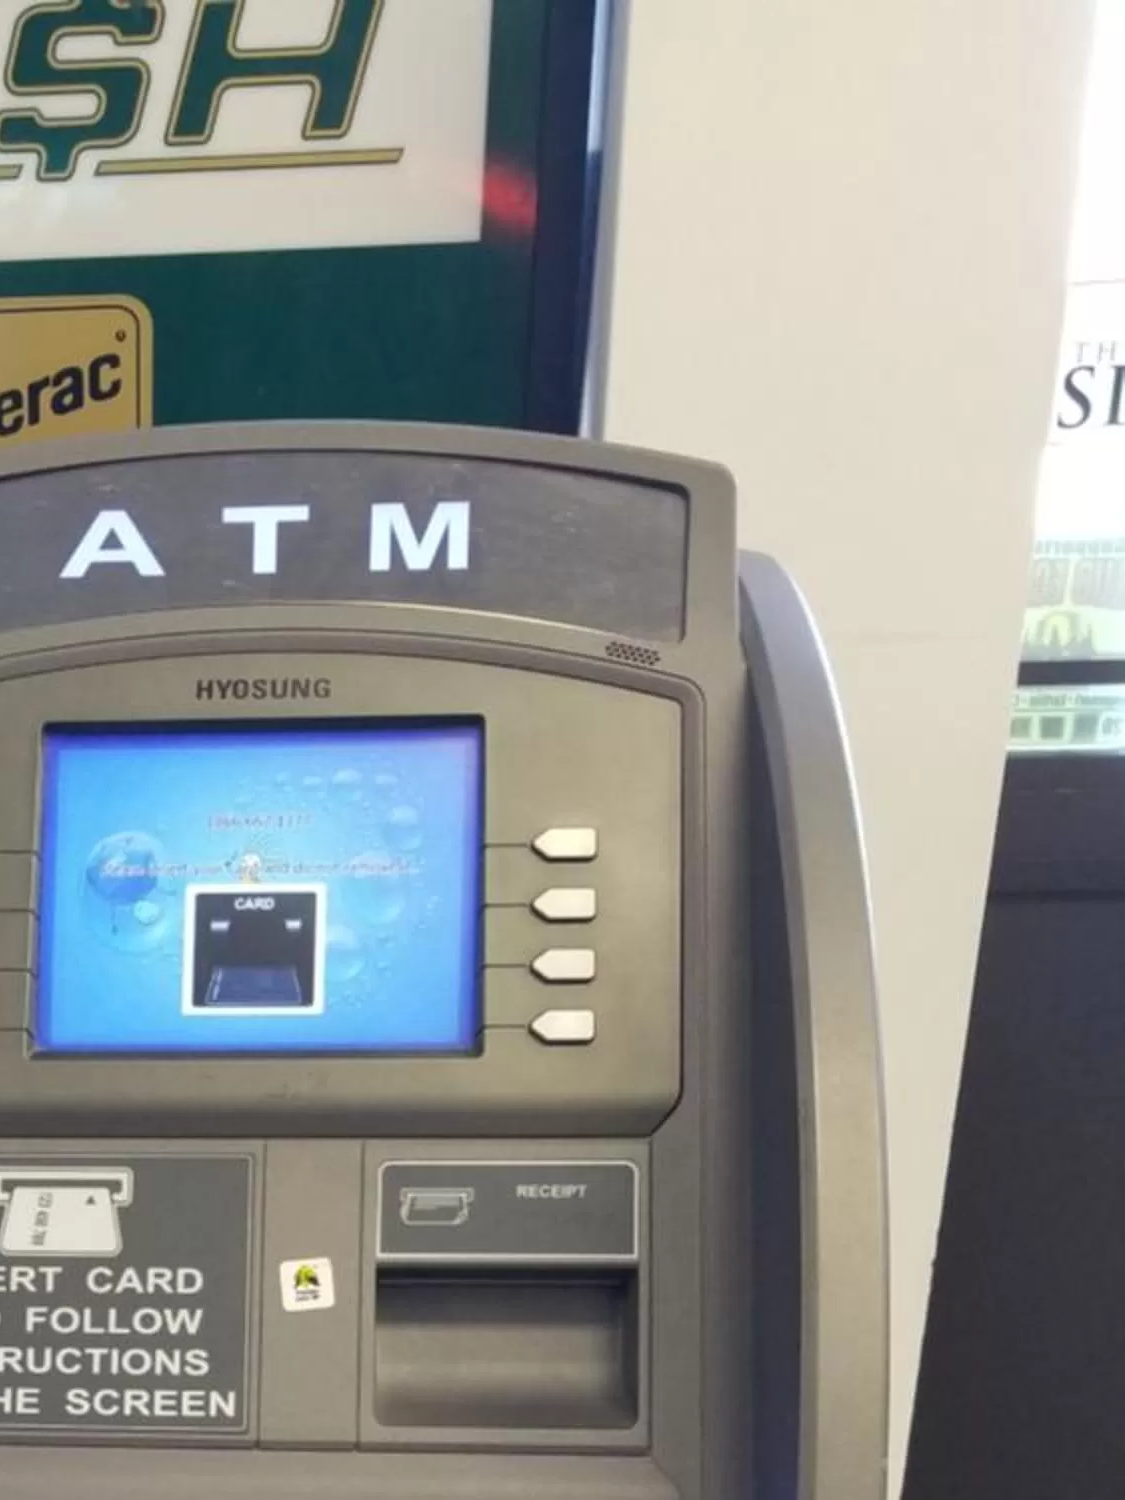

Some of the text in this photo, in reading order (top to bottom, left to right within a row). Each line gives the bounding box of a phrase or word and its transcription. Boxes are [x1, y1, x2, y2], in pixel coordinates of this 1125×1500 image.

[195, 677, 333, 701] HYOSUNG
[234, 897, 276, 911] CARD
[515, 1184, 587, 1199] RECEIPT
[86, 1266, 203, 1295] CARD
[26, 1306, 203, 1335] FOLLOW
[65, 1388, 236, 1418] SCREEN
